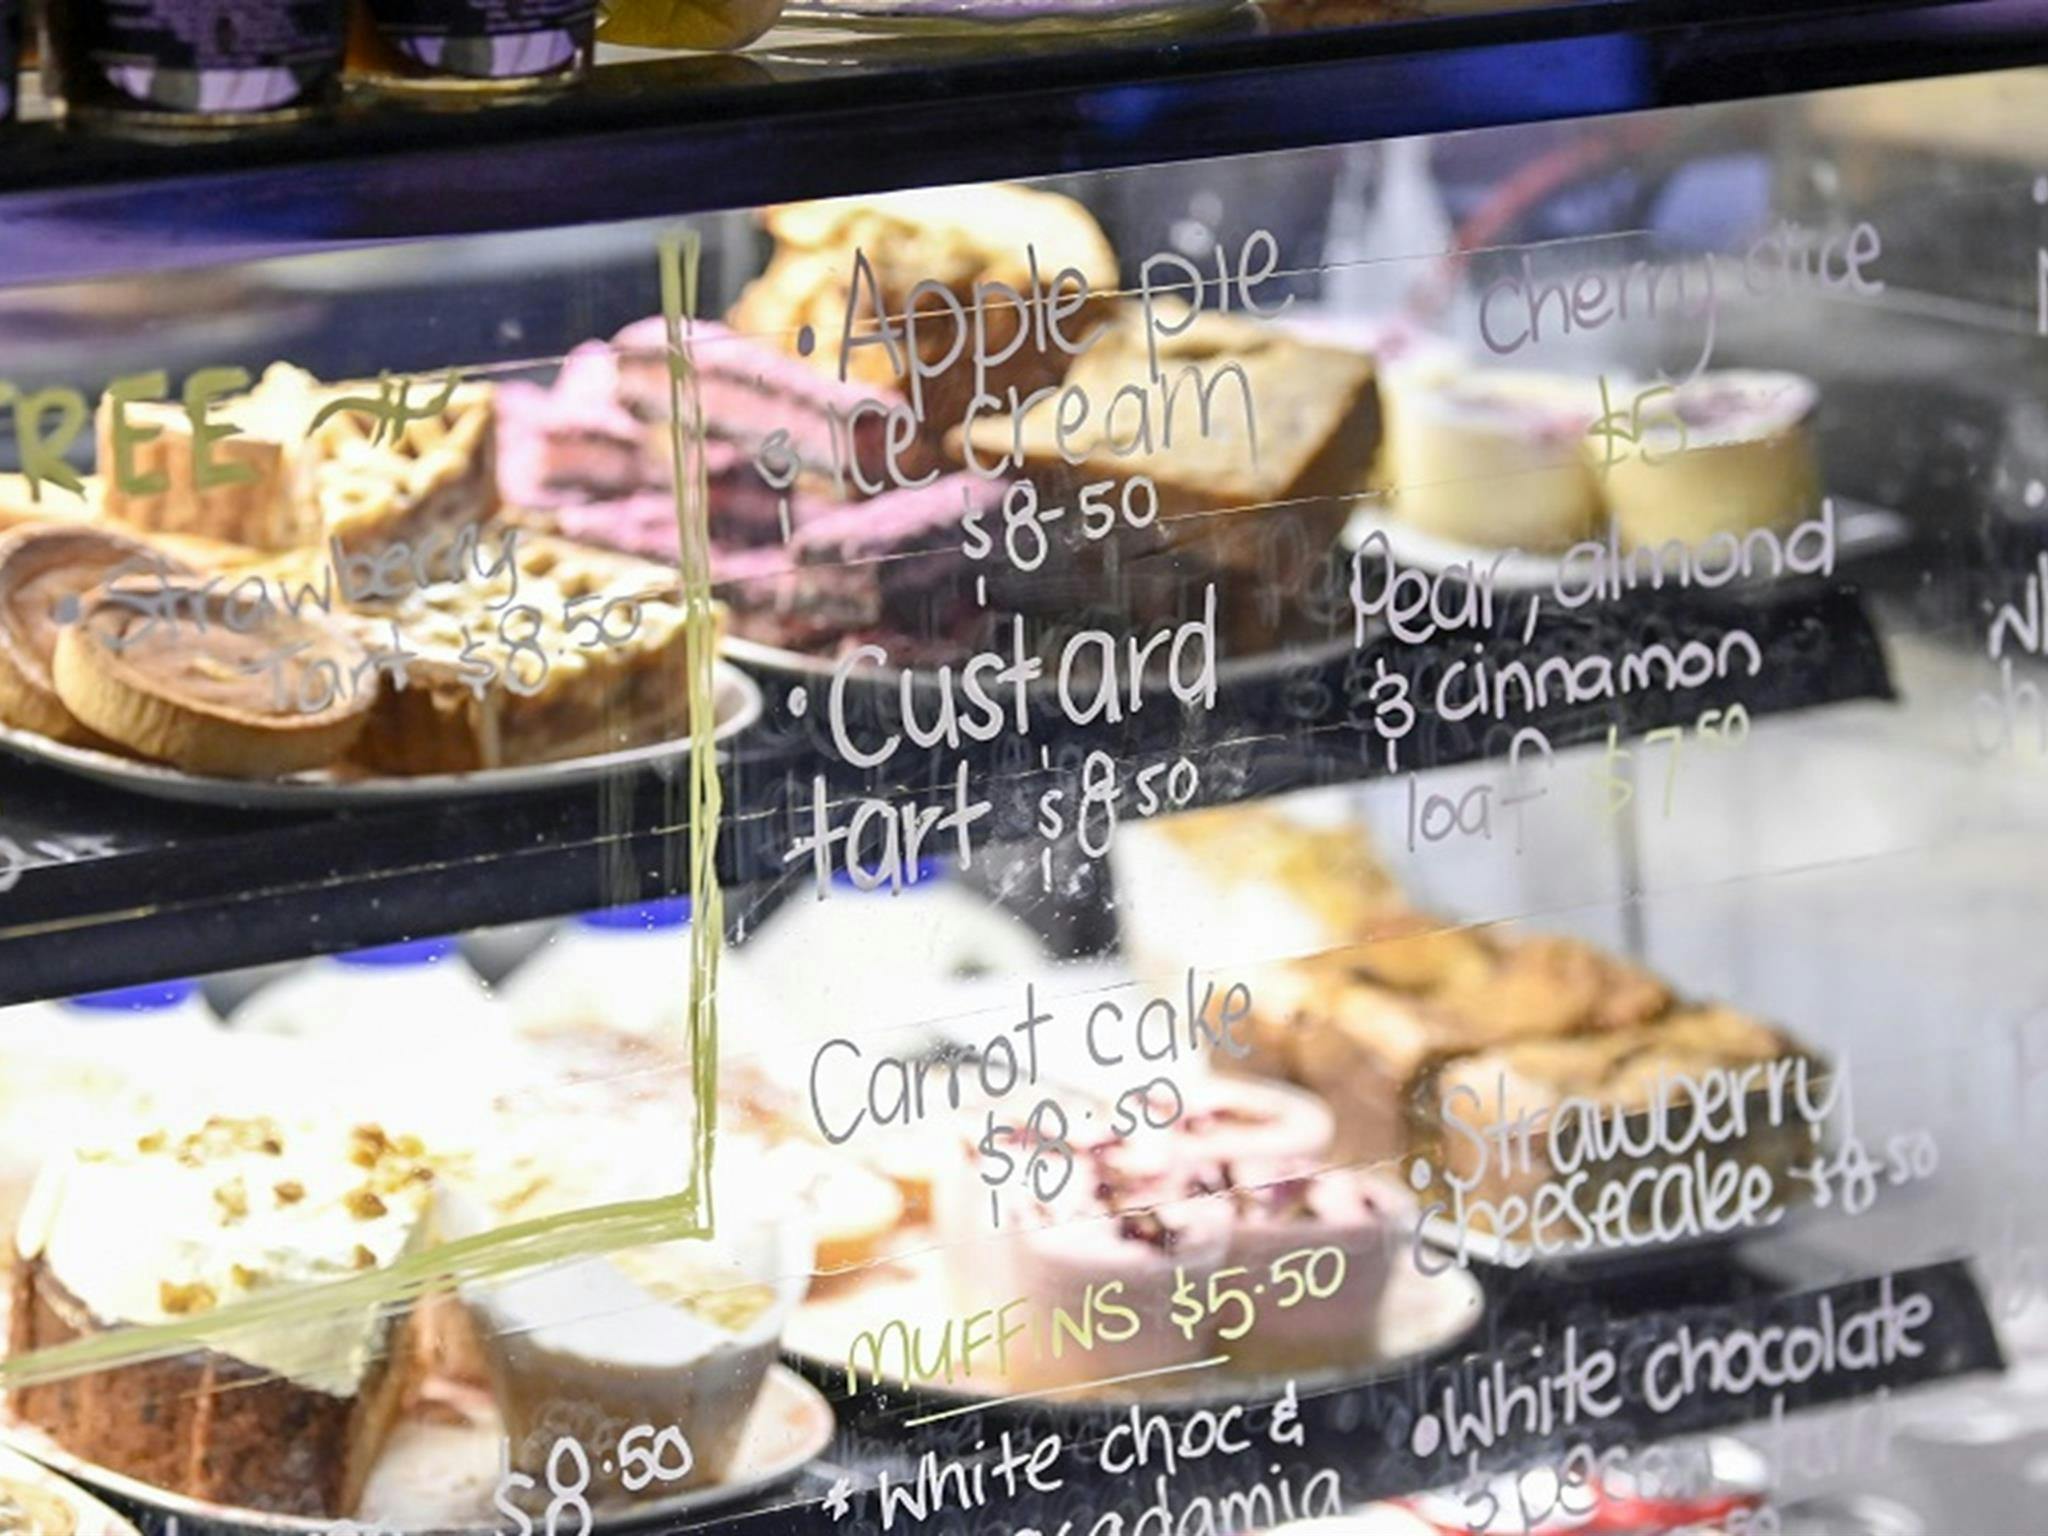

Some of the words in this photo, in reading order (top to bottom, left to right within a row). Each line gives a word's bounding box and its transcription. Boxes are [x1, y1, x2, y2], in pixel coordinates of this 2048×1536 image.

[838, 244, 1107, 422] Apple
[1140, 228, 1295, 384] pie
[0, 367, 253, 502] REE
[962, 360, 1261, 480] cream
[1553, 498, 1838, 608] almond
[828, 582, 1218, 770] Custard
[1435, 628, 1764, 722] cinnamon
[783, 759, 992, 902] tart
[809, 982, 1055, 1144] Carrot
[1086, 967, 1255, 1066] cake
[1440, 1058, 1852, 1192] Strawberry
[1170, 1246, 1347, 1340] $5.50
[1443, 1325, 1624, 1458] White
[1644, 1272, 1934, 1414] chocolate
[878, 1431, 1065, 1532] White
[1099, 1403, 1252, 1475] choc
